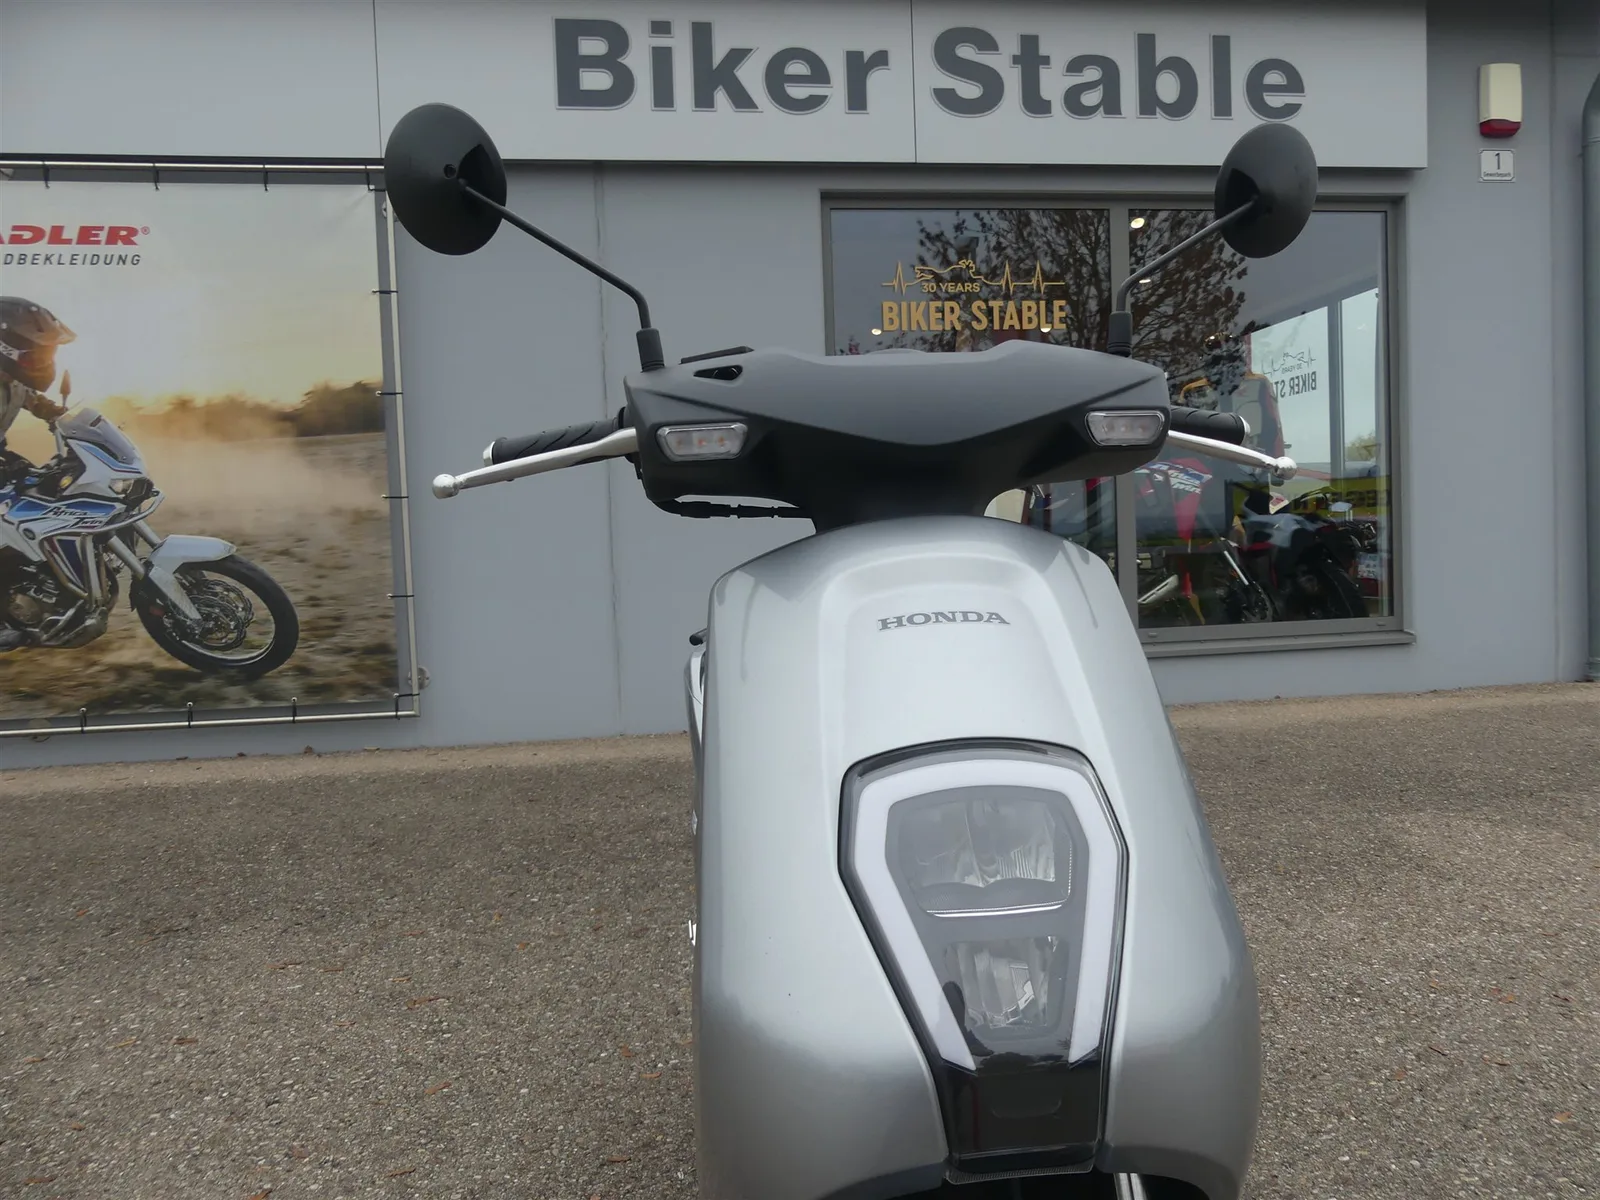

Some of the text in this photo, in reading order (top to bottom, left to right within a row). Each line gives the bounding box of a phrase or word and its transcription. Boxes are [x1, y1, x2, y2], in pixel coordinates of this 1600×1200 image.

[552, 17, 1306, 121] Biker Stable
[1494, 152, 1501, 170] 1
[0, 225, 139, 246] DLER
[3, 253, 142, 266] DBEKLEIDUNG
[921, 282, 981, 293] 30 YEARS
[882, 300, 1067, 331] BIKER STABLE
[41, 506, 88, 517] Africa
[69, 516, 103, 529] Twin
[877, 610, 1011, 631] HONDA
